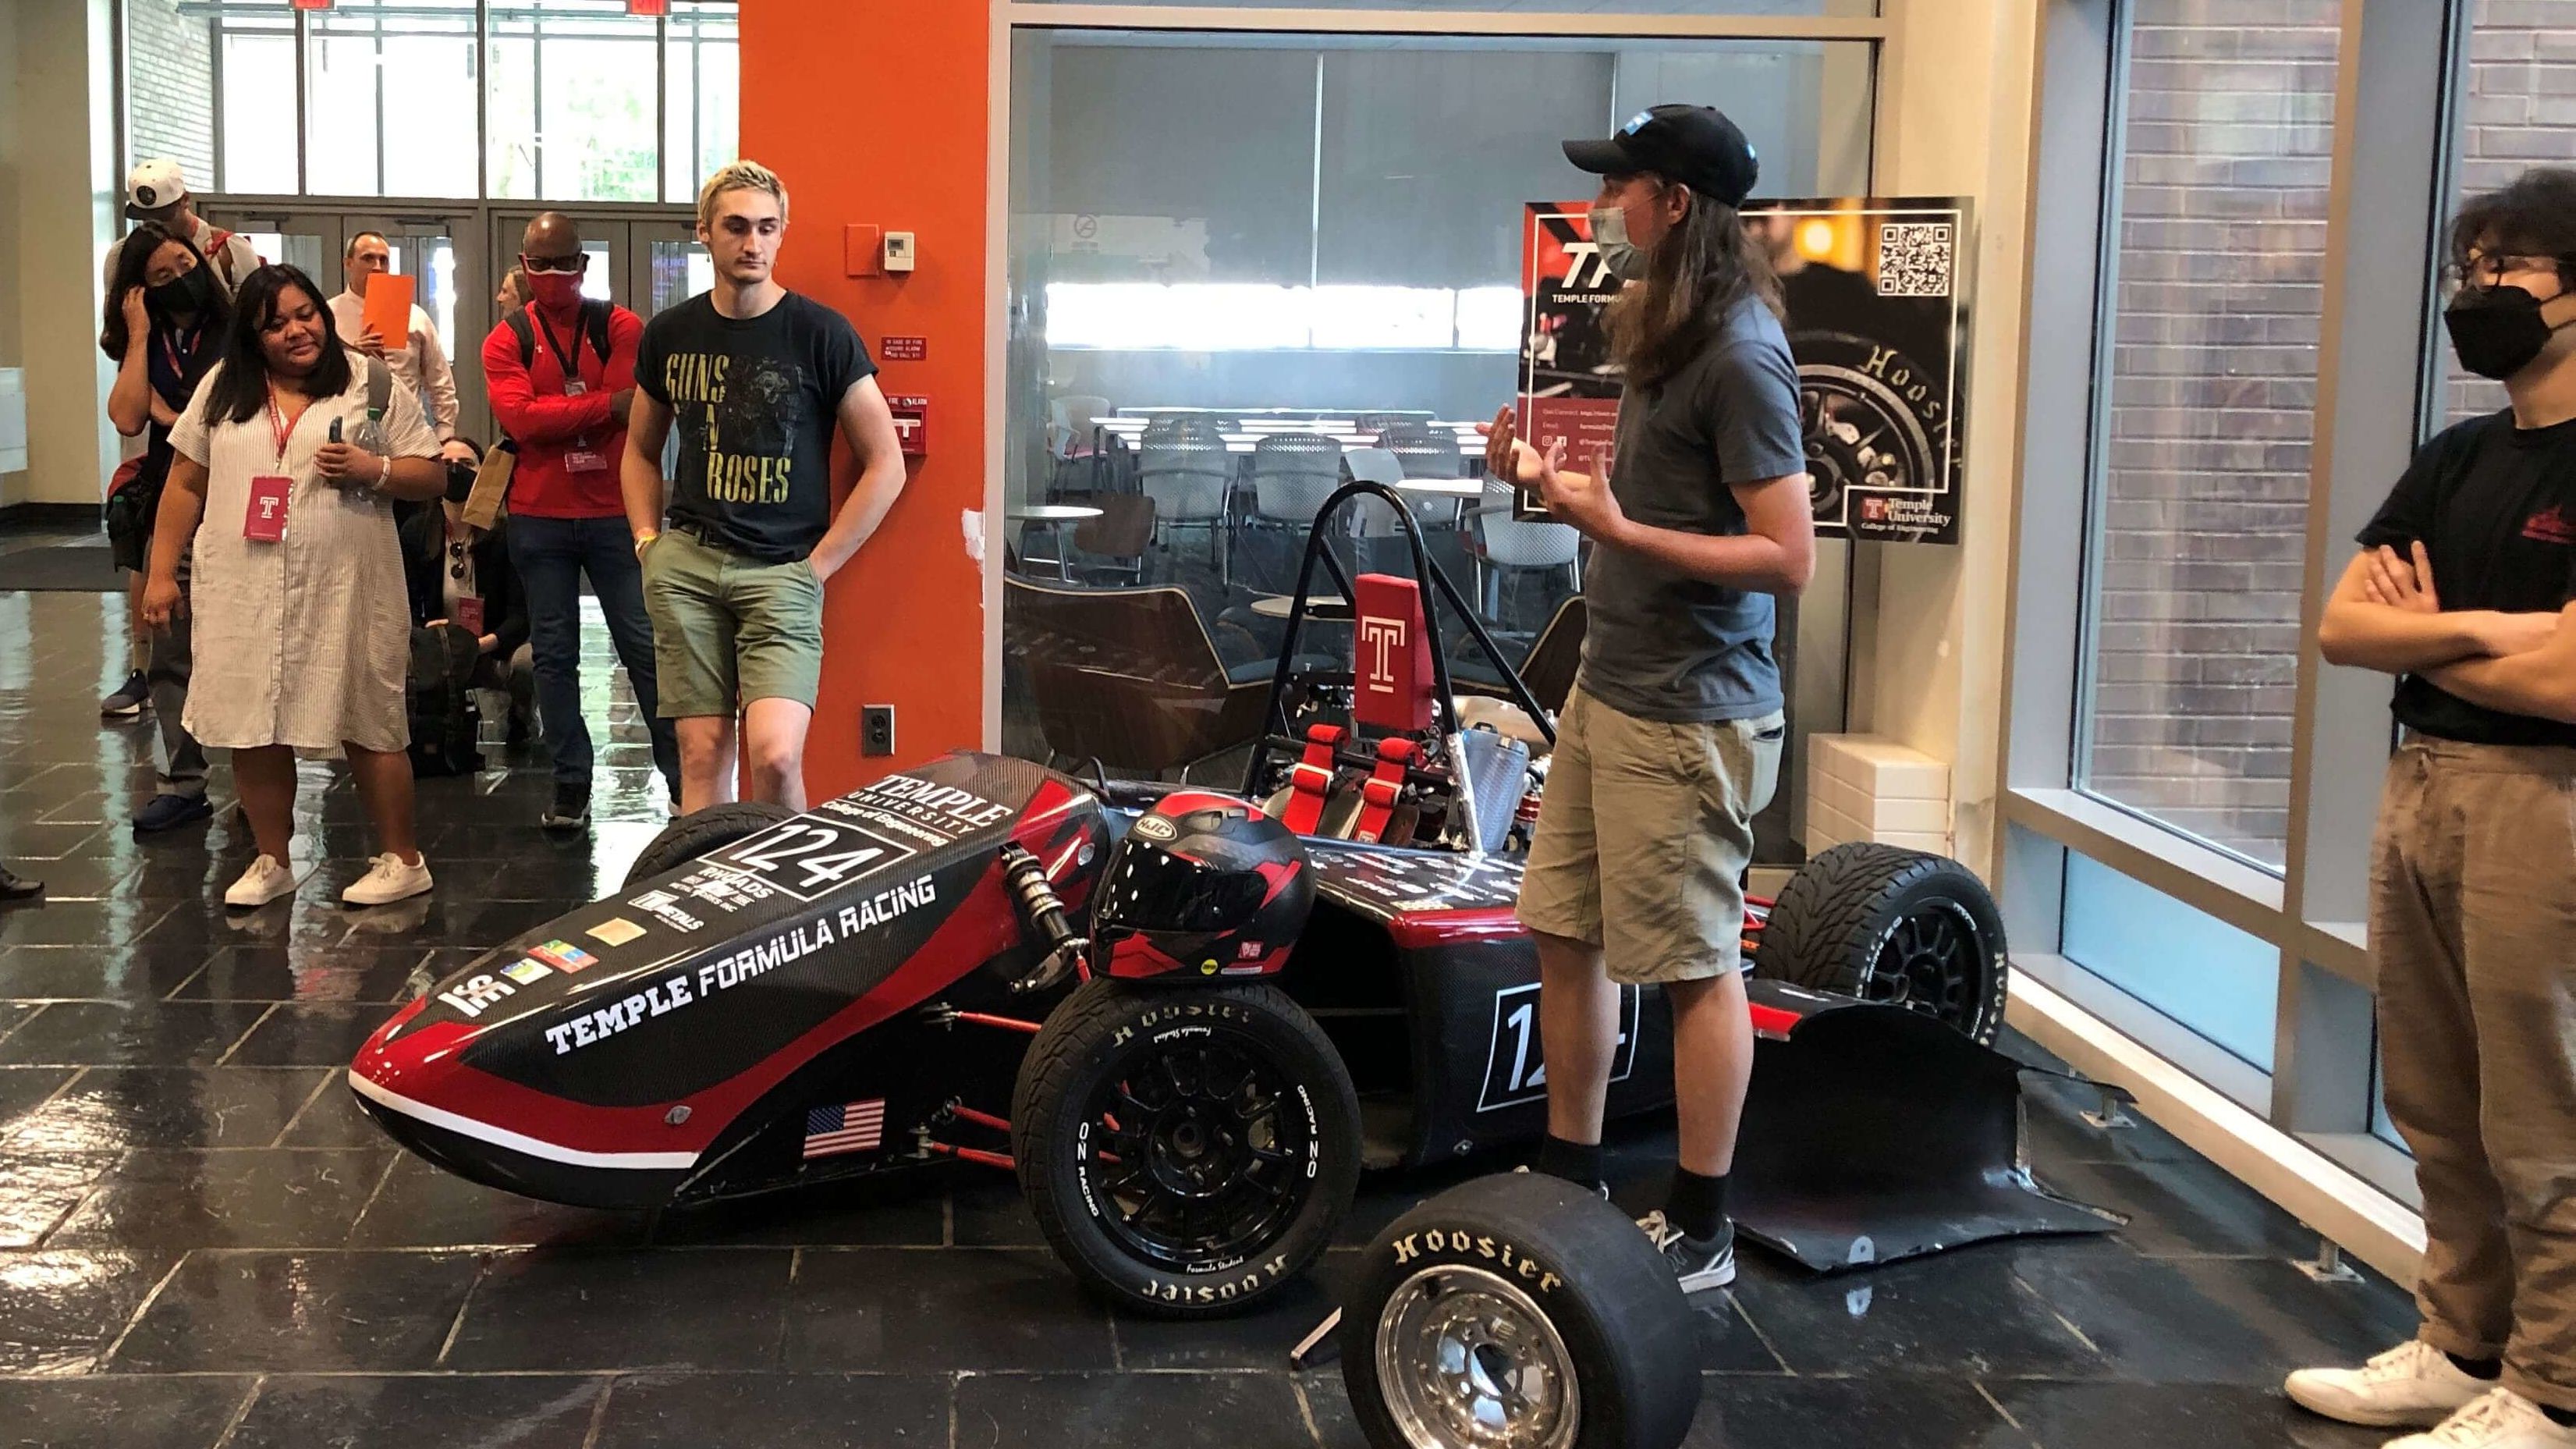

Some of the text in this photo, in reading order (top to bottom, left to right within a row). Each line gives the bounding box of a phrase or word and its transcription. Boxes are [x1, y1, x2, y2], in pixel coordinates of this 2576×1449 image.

[1552, 294, 1621, 304] TEMPLE FORMU
[666, 353, 729, 403] GUNS
[707, 452, 791, 503] ROSES
[260, 496, 279, 519] T
[1888, 498, 1933, 513] Temple
[1888, 511, 1951, 527] University
[1361, 616, 1405, 693] T
[821, 801, 864, 815] College
[874, 813, 949, 847] Engineering
[847, 790, 975, 834] UNIVERSITY
[861, 774, 1013, 827] TEMPLE
[729, 823, 885, 888] 124
[546, 874, 936, 1055] TEMPLE FORMULA RACING
[1297, 1085, 1318, 1135] RACING
[1078, 1167, 1099, 1217] RACING
[1187, 1255, 1244, 1273] Formula Student
[1393, 1228, 1561, 1293] Hoosier
